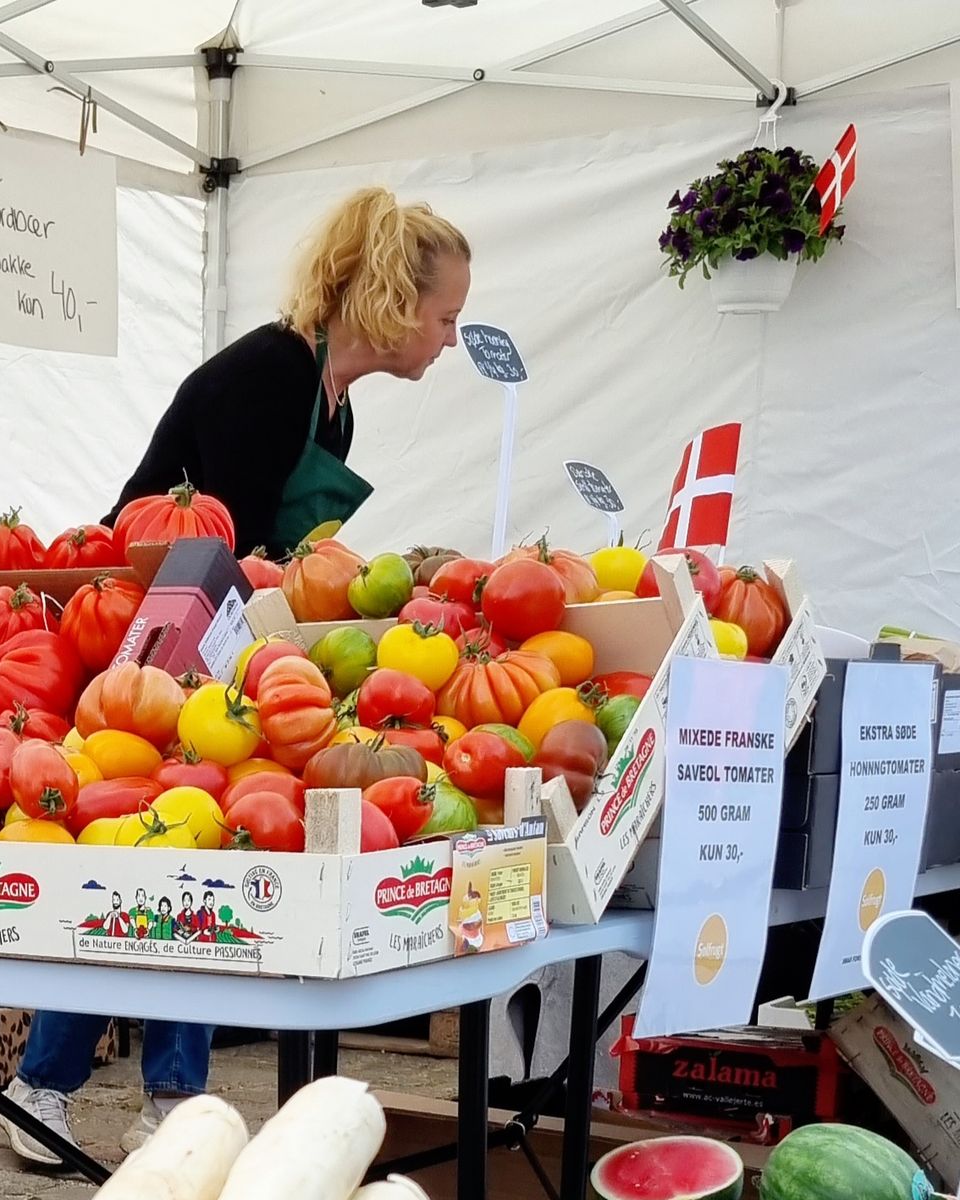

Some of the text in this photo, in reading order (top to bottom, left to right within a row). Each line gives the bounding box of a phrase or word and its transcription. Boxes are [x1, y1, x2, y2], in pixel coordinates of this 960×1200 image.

[51, 271, 97, 332] 40,-
[679, 728, 774, 749] MIXEDE FRANSKE
[860, 725, 916, 741] EKSTRA SØDE
[601, 794, 623, 834] PRINCE
[626, 732, 655, 788] BRETAGNE
[677, 764, 774, 783] SAVEOL TOMATER
[864, 794, 905, 811] 250 GRAM
[698, 805, 751, 822] 500 GRAM
[864, 829, 898, 846] KUN 30,-
[699, 844, 743, 863] KUN 30,-
[377, 877, 451, 905] PRINCE de BRETAGN
[79, 938, 90, 948] de
[93, 939, 122, 951] Nature
[163, 943, 174, 953] de
[177, 944, 211, 956] Culture
[390, 932, 401, 951] LES
[672, 1056, 777, 1088] zalama
